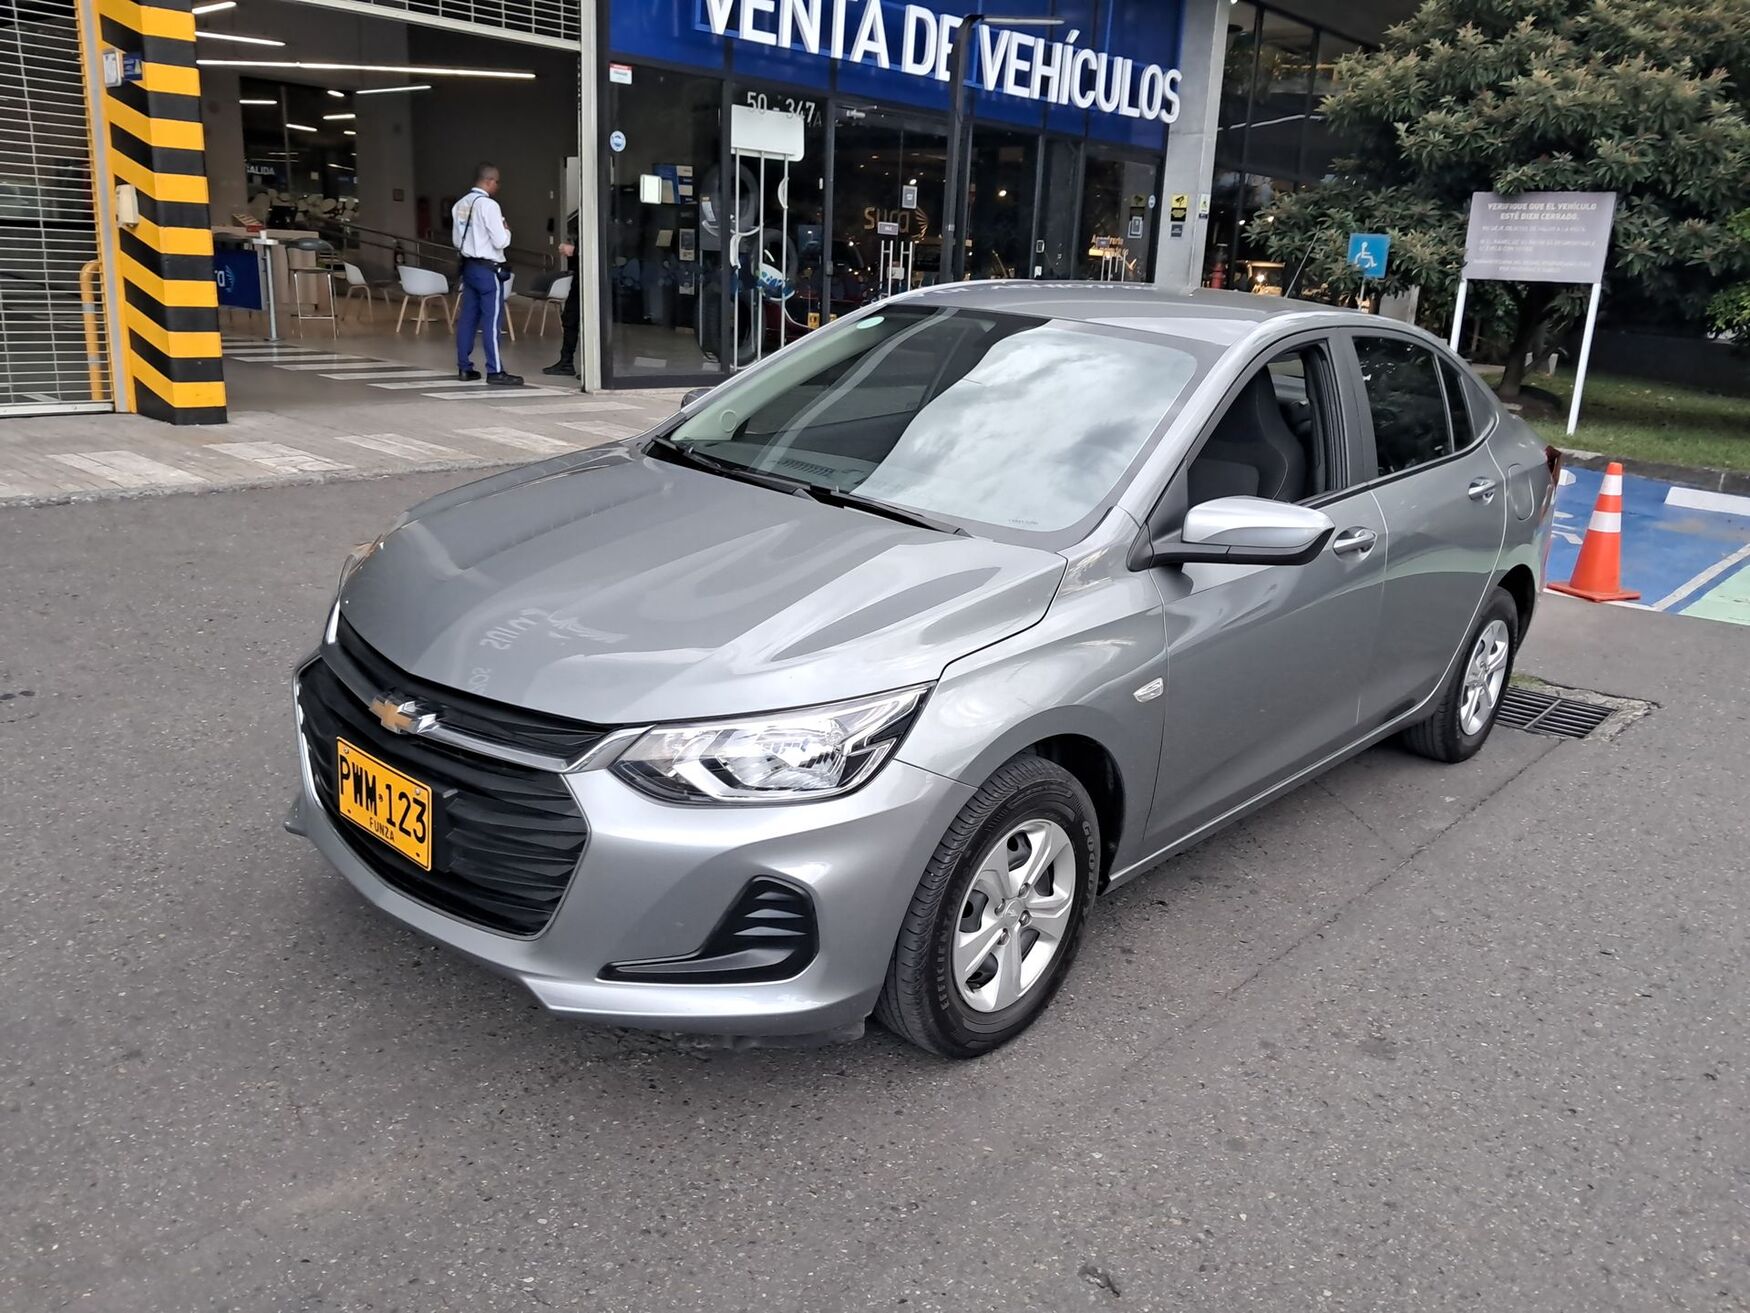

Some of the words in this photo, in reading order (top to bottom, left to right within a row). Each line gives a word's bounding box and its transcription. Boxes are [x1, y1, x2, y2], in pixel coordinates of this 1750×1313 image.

[902, 4, 963, 82] DE
[979, 24, 1183, 124] VEHÍCULOS
[747, 91, 767, 115] 50
[786, 98, 816, 123] 347
[370, 816, 396, 842] FUNZA
